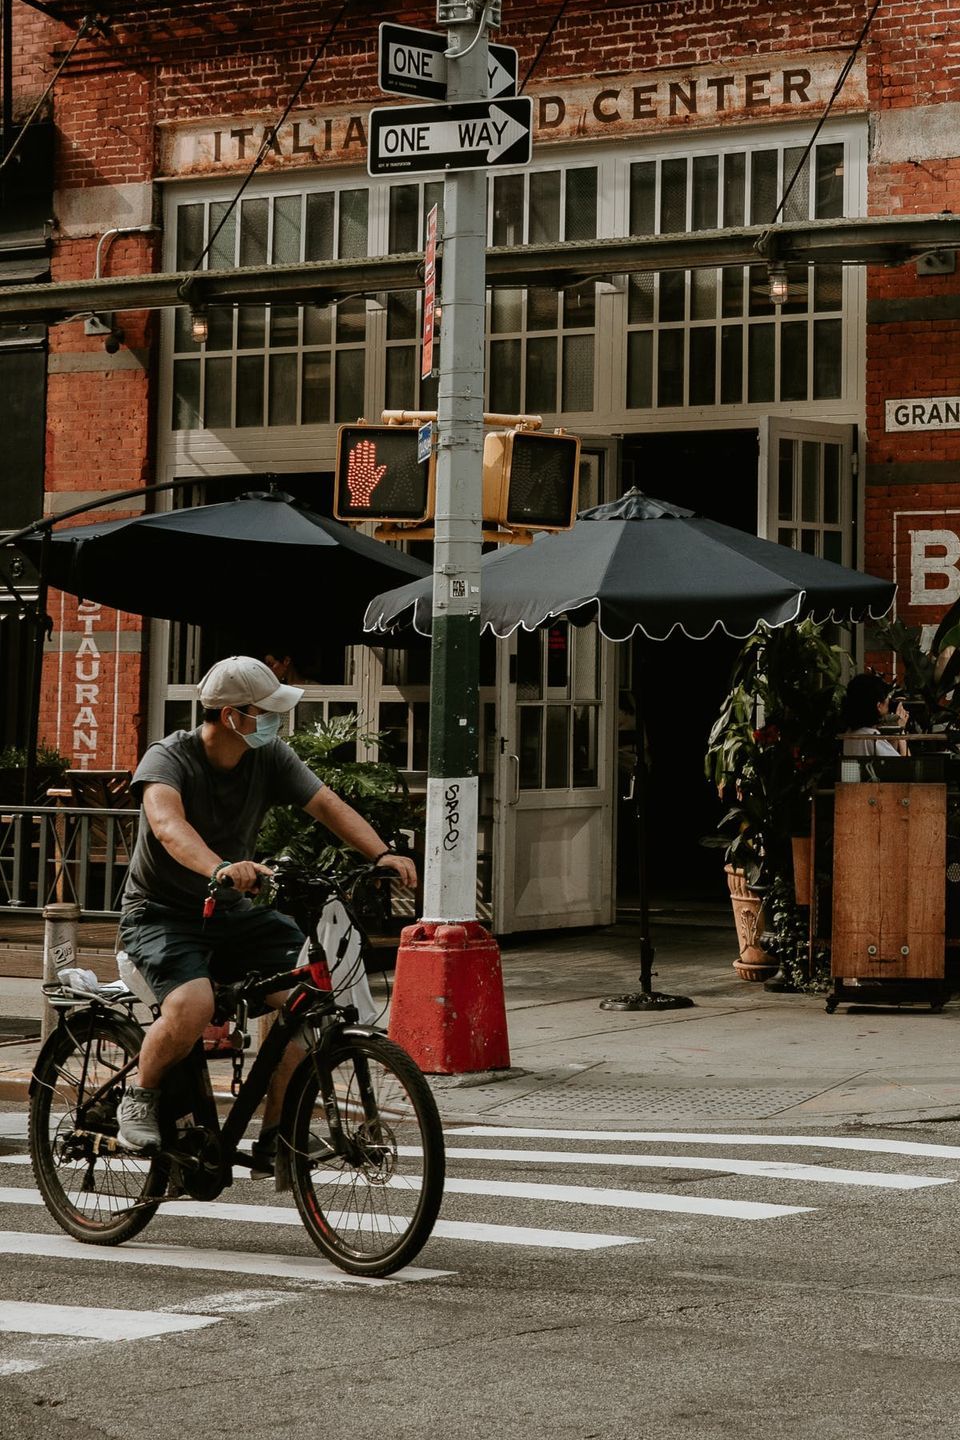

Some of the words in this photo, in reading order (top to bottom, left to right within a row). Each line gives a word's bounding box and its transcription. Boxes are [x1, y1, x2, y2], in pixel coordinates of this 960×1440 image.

[393, 47, 433, 78] ONE
[592, 68, 812, 123] CENTER
[384, 126, 430, 154] ONE
[457, 120, 509, 148] WAY
